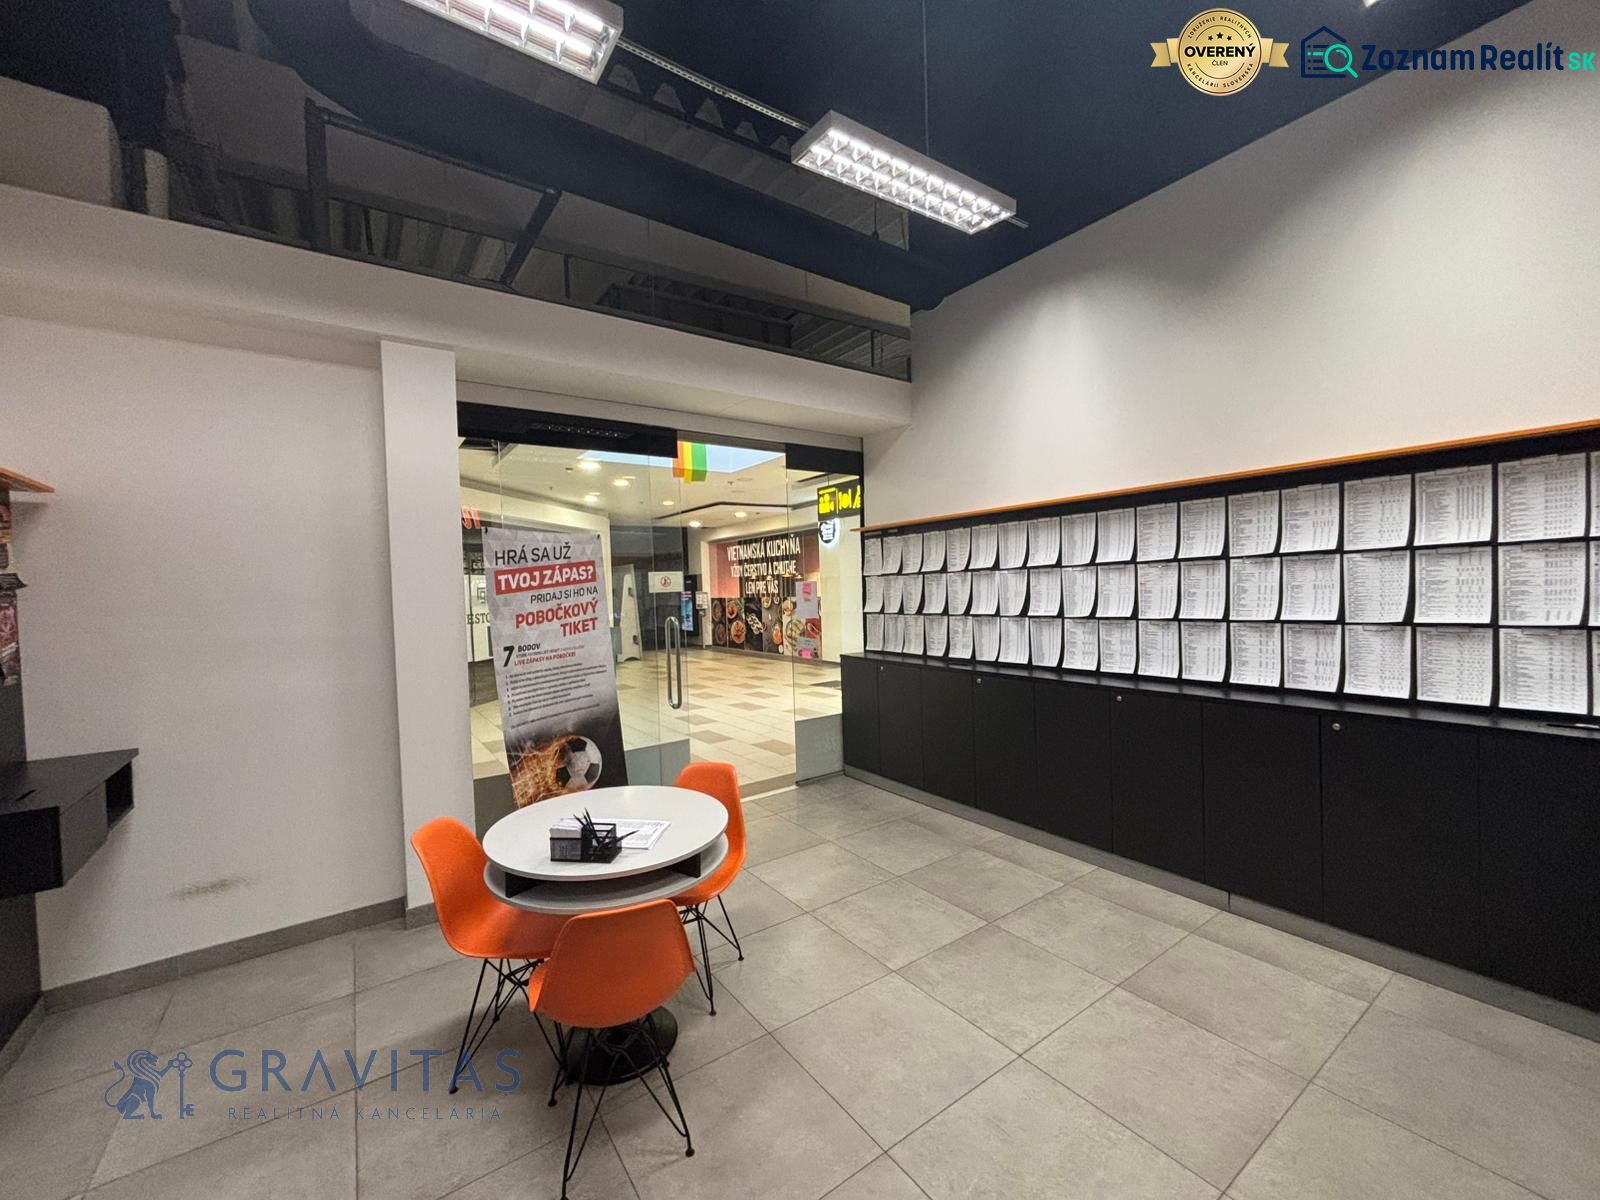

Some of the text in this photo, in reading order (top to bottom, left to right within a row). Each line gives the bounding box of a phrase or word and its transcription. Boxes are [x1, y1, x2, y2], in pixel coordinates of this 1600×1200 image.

[494, 542, 571, 566] HRÁ SA UŽ
[727, 534, 801, 561] VIETNAMSKÁ KUCHYŇA
[498, 565, 594, 591] TVOJ ZÁPAS?
[768, 562, 773, 575] A
[530, 585, 599, 604] PRIDAJ SI HO NA
[756, 580, 766, 594] PRE
[515, 597, 599, 629] POBOČKOVÝ
[560, 617, 599, 638] TIKET
[503, 645, 515, 668] 7
[517, 643, 541, 653] BODOV
